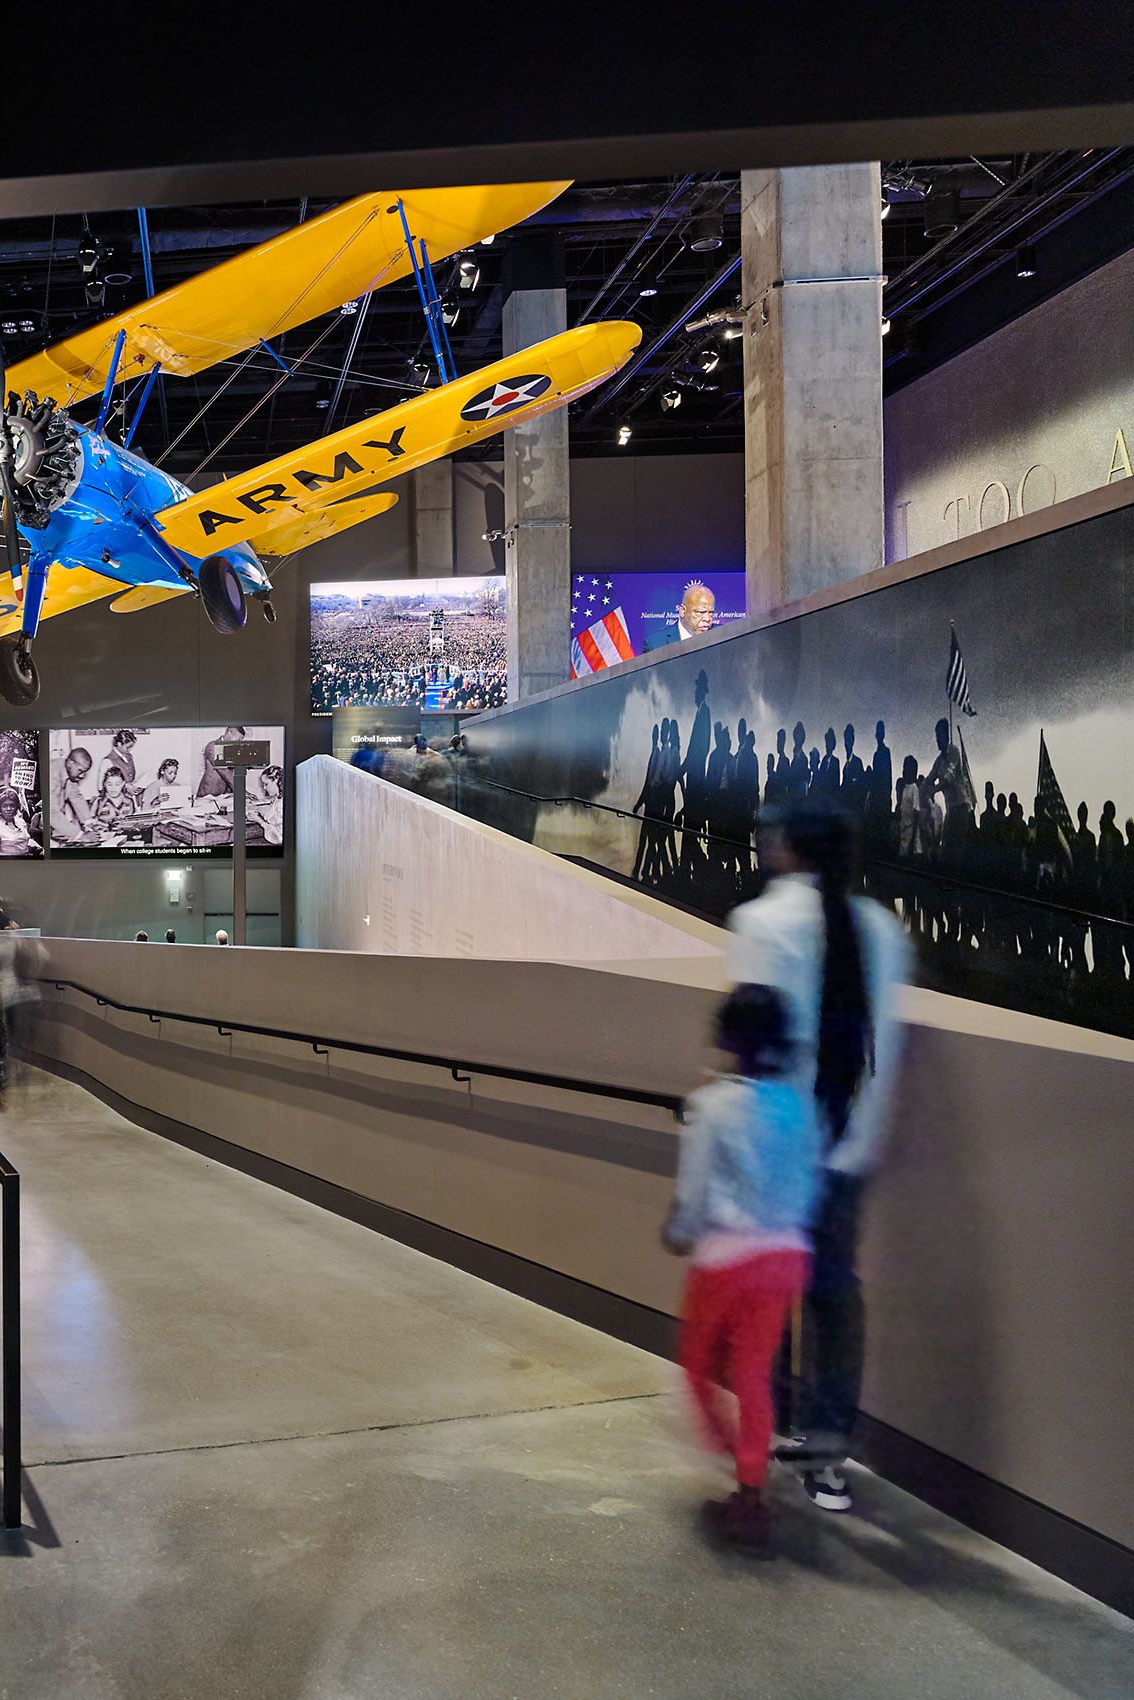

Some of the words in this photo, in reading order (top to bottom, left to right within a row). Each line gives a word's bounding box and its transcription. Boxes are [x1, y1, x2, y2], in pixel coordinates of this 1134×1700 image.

[197, 426, 407, 536] ARMY
[944, 463, 1057, 539] TOO
[351, 735, 375, 743] Global
[376, 735, 402, 744] Impact
